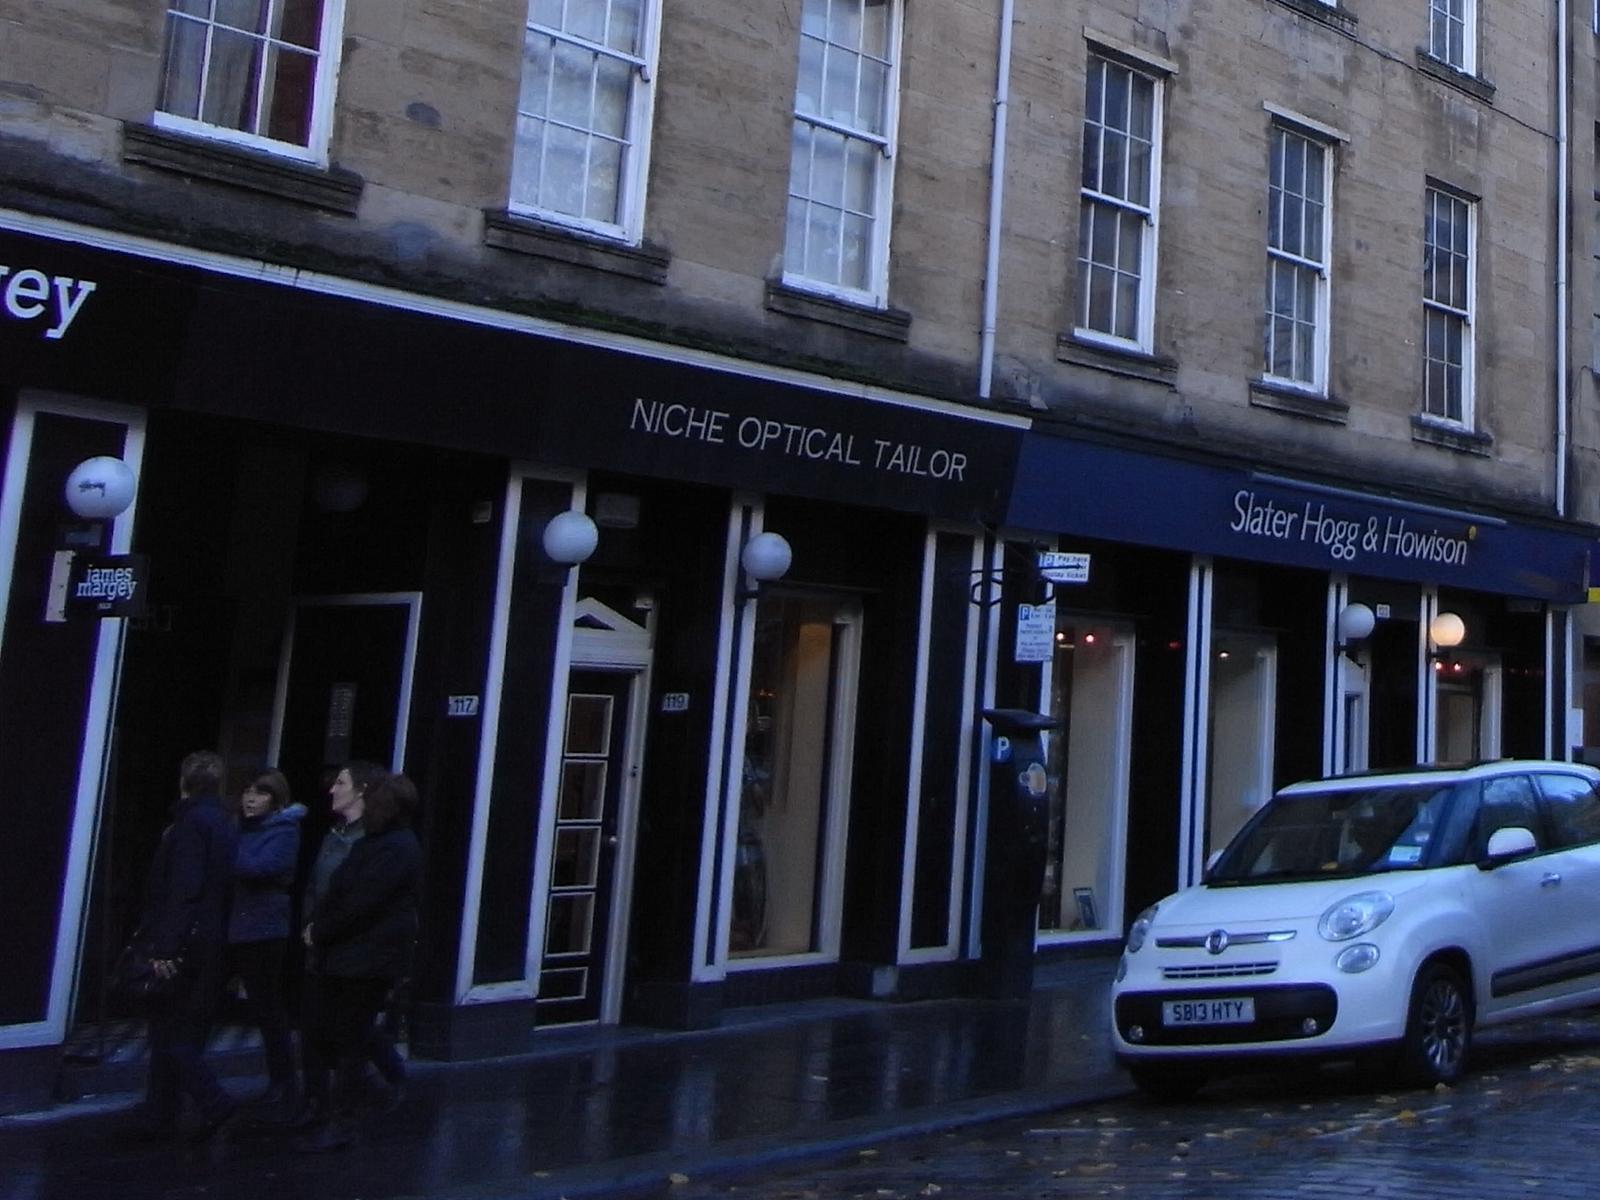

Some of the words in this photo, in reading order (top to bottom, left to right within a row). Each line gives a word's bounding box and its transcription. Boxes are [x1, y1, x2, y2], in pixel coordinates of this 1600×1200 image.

[629, 398, 729, 443] NICHE
[738, 416, 861, 466] OPTICAL
[873, 439, 967, 482] TAILOR
[1230, 489, 1298, 540] Slater
[1300, 501, 1360, 561] Hogg
[1362, 515, 1379, 552] &
[1382, 515, 1468, 566] Howison
[86, 564, 134, 582] james
[76, 580, 137, 600] margey
[454, 697, 473, 713] 117
[666, 694, 686, 709] 119
[997, 735, 1010, 760] P
[1172, 1003, 1208, 1022] SB13
[1211, 1001, 1244, 1020] HTY
